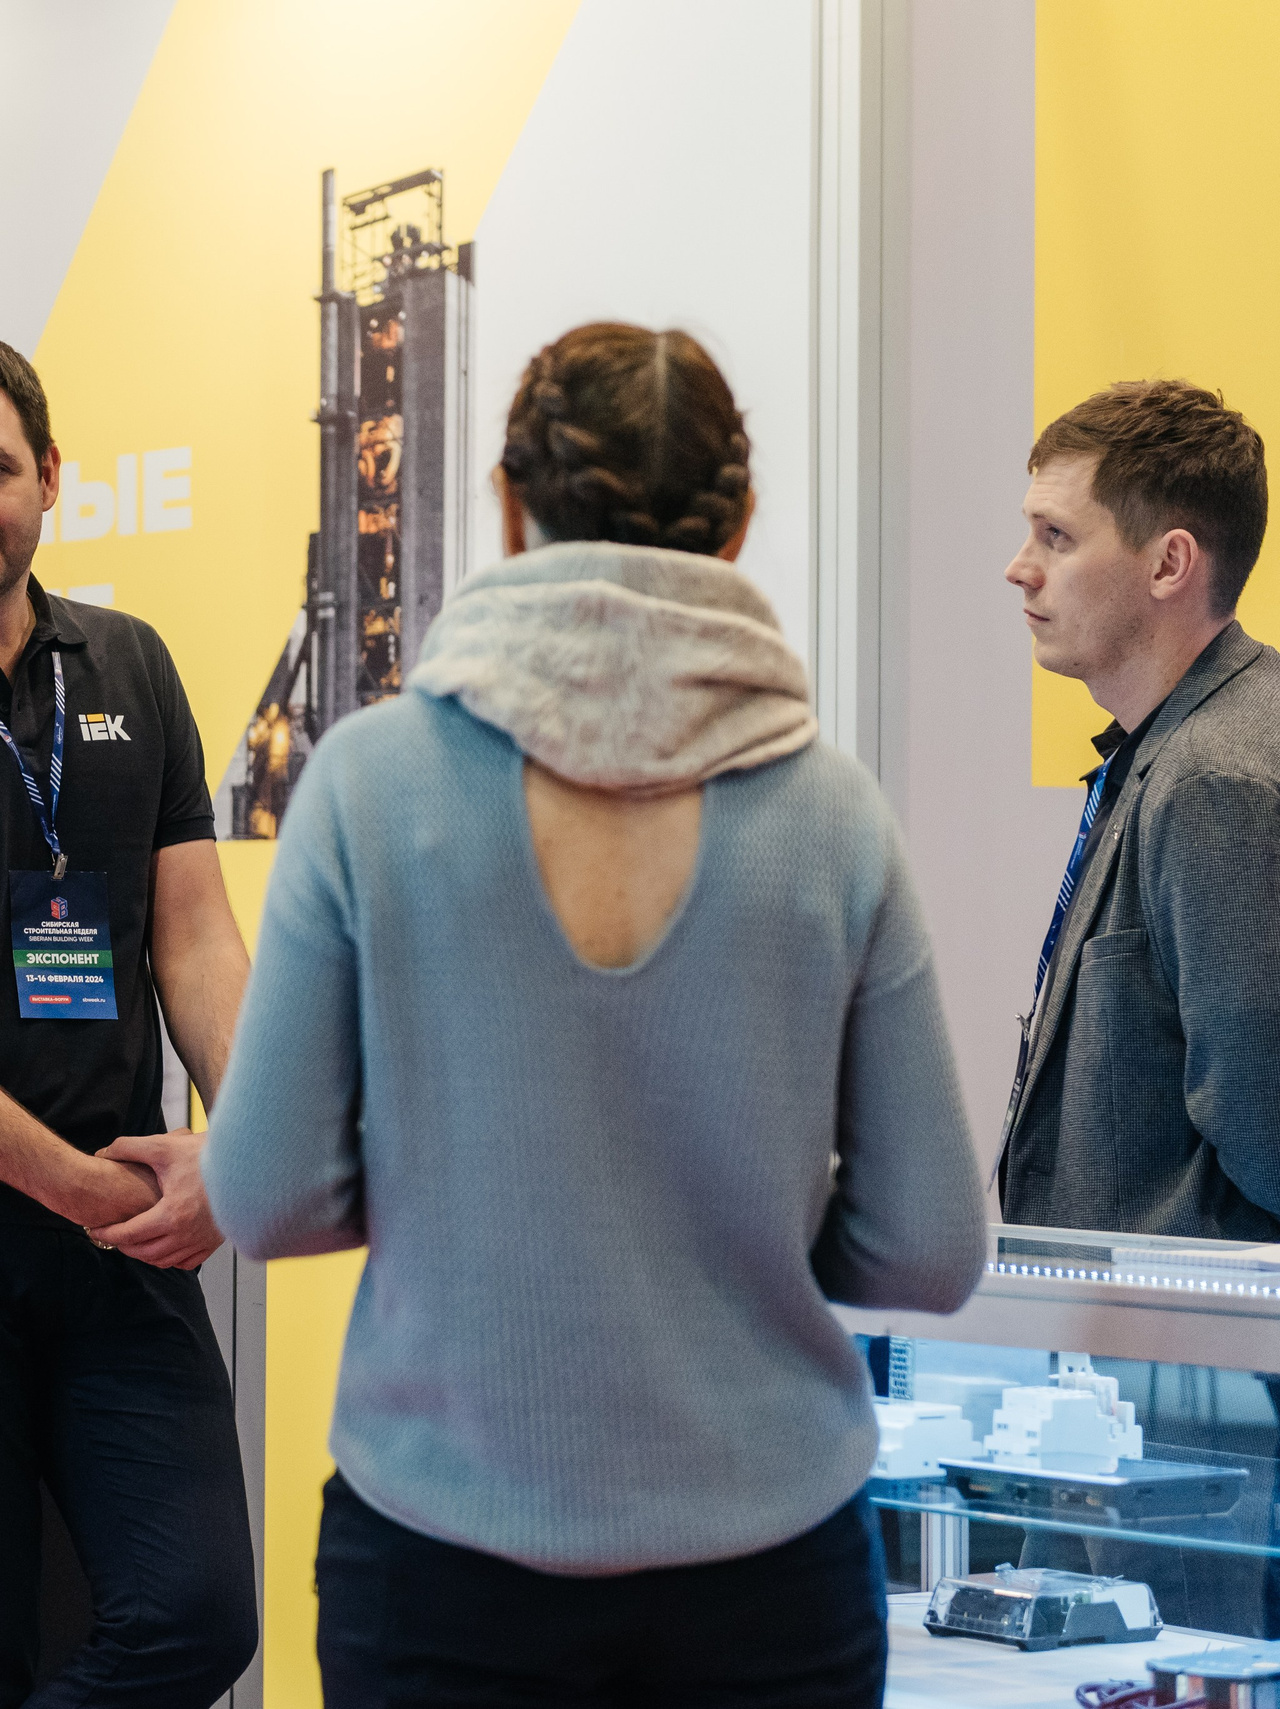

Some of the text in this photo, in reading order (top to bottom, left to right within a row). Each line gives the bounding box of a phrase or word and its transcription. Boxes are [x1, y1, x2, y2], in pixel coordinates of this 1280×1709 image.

[26, 953, 99, 965] ЭКСПОНЕНТ
[47, 975, 84, 983] ФЕВРАЛЯ
[85, 975, 104, 984] 2024
